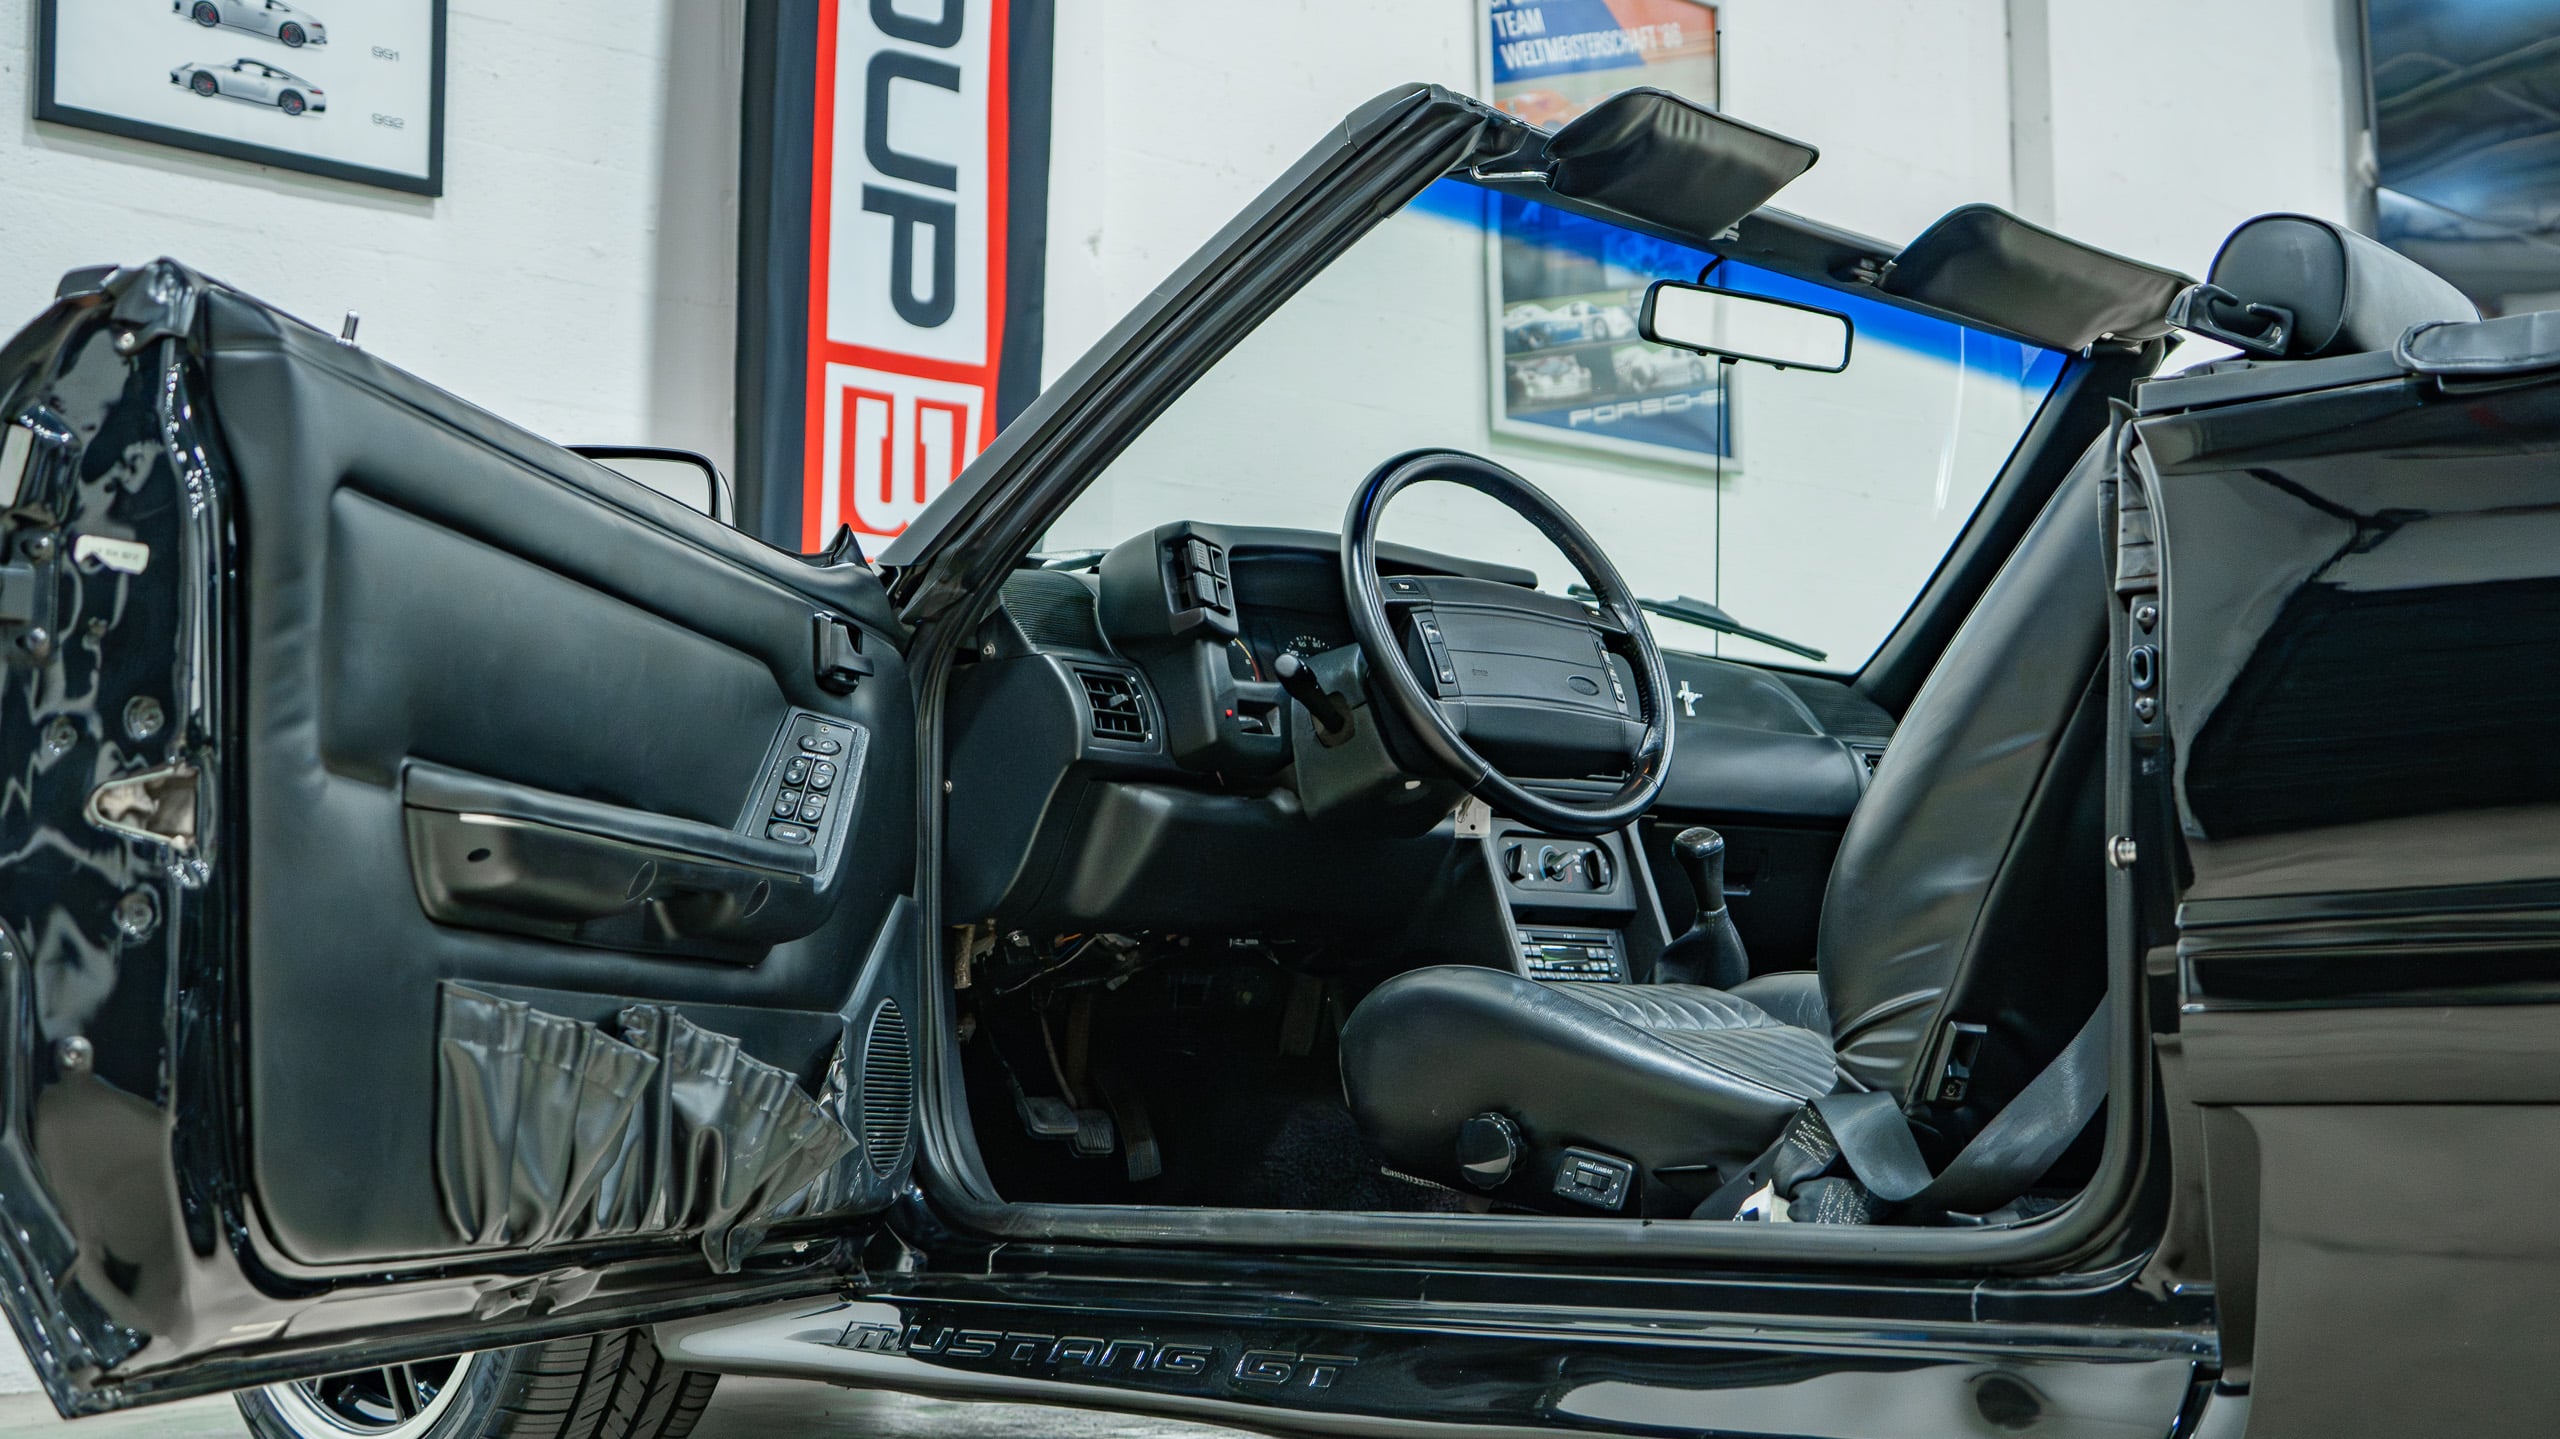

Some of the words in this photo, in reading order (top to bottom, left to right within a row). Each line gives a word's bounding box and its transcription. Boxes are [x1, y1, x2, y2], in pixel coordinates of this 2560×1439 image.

[1492, 7, 1546, 38] TEAM
[371, 45, 400, 62] 991
[1499, 24, 1658, 70] WELTMEISTERSCHAFT
[1568, 388, 1726, 428] PORSCHE
[835, 1320, 1213, 1375] MUSTANG
[1234, 1350, 1359, 1389] GT
